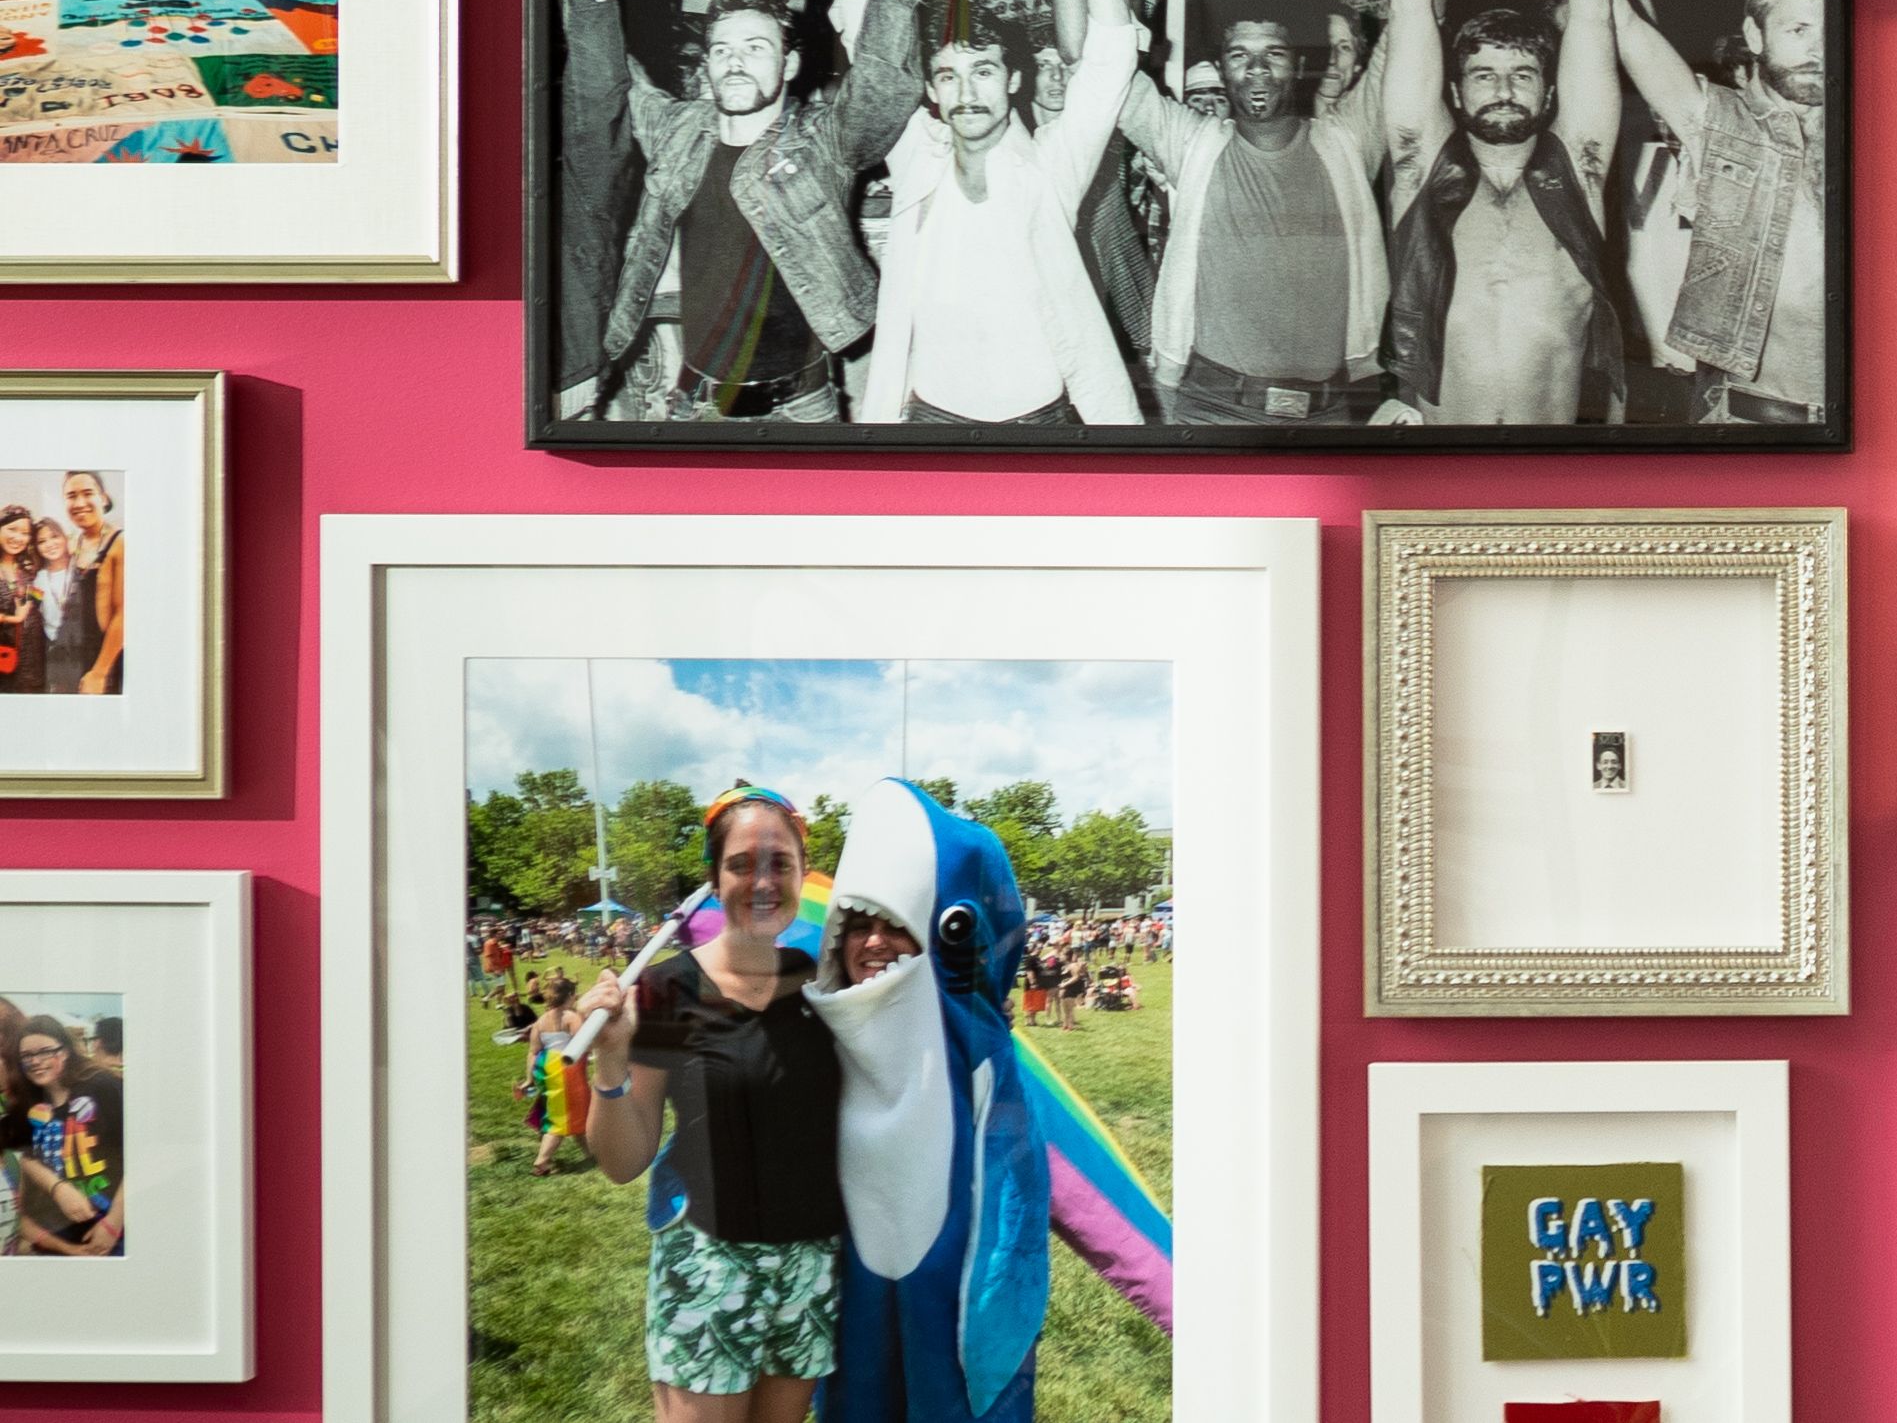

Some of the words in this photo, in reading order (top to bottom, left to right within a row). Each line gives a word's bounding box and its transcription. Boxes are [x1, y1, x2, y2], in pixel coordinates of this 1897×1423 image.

[66, 124, 122, 149] CRUZ
[1528, 1197, 1656, 1261] GAY
[1530, 1259, 1661, 1318] PWR
